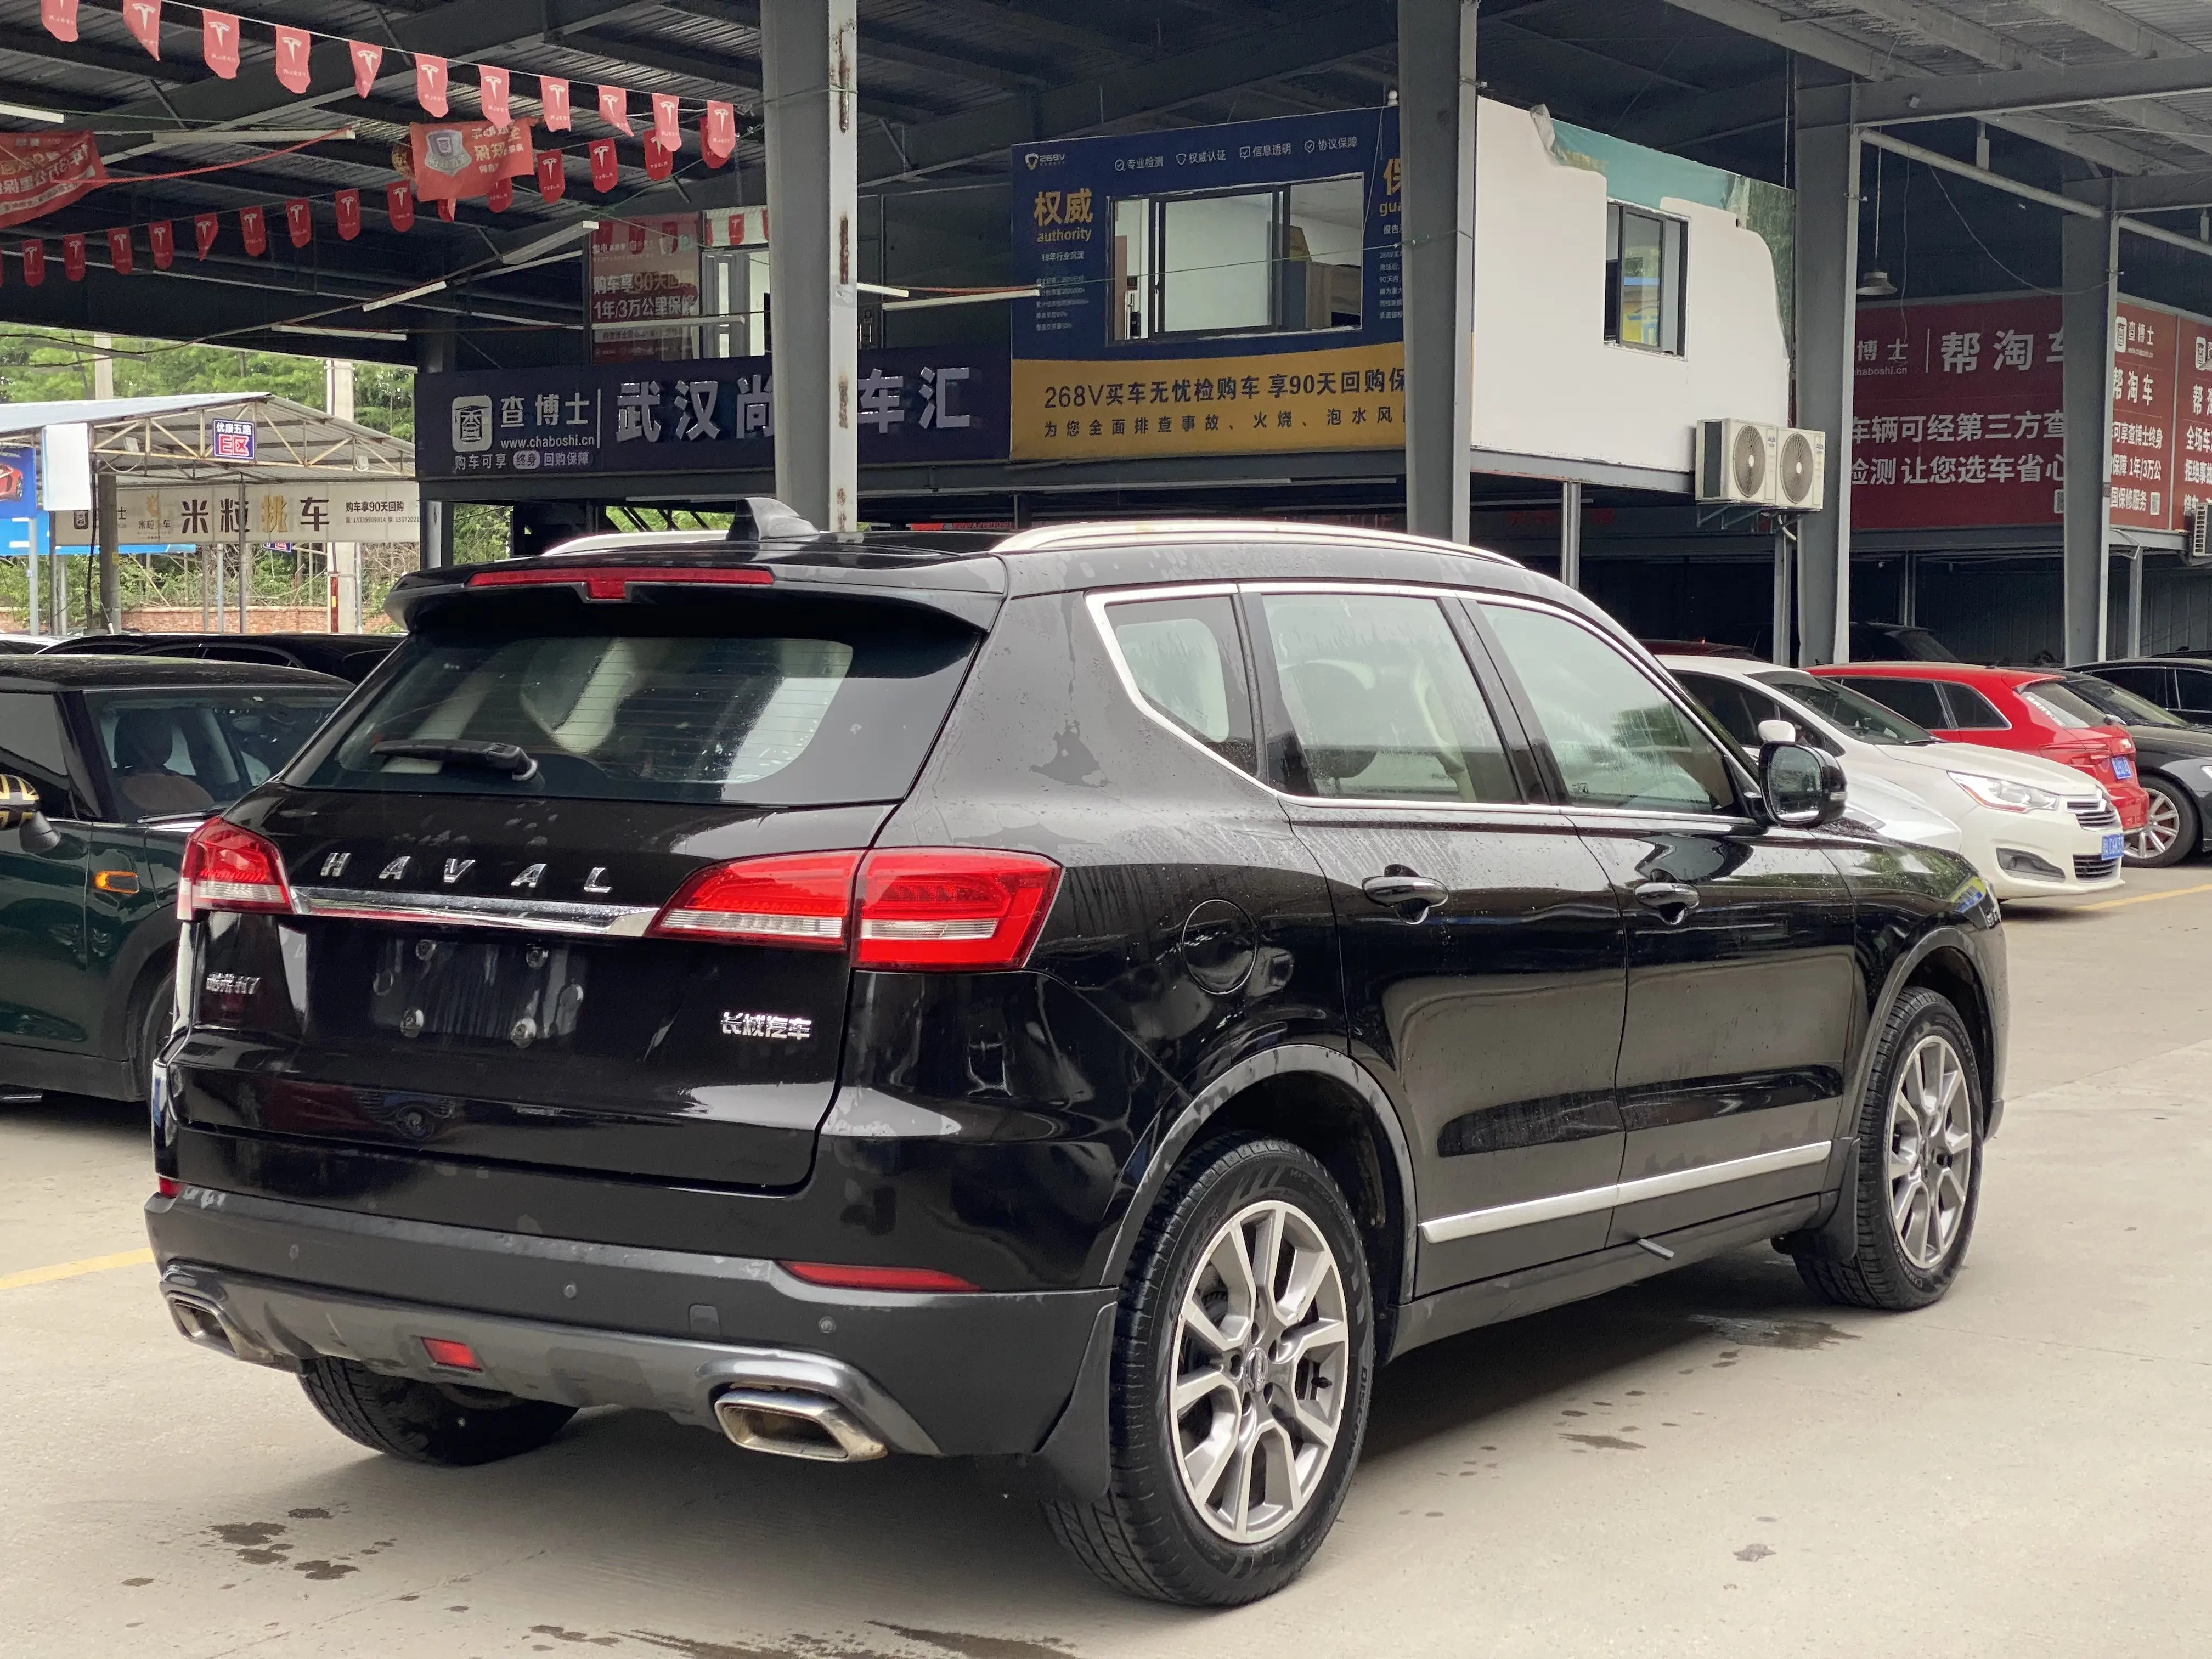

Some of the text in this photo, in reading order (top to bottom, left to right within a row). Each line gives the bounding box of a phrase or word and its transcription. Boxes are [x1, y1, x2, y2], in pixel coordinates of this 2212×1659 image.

[1127, 136, 1357, 170] 专业检测 权威认证 信息透明 协议保障
[1034, 188, 1093, 226] 权威
[1037, 227, 1092, 242] authority
[1857, 338, 1908, 362] 博士
[1854, 365, 1907, 376] haboshi.cn
[1044, 368, 1405, 408] 268V买车无忧检购车 享90天回购保
[501, 392, 590, 428] 查博士
[1044, 406, 1406, 438] 为您全面排查事故、火烧、泡水风
[219, 434, 250, 456] E区
[501, 435, 595, 449] www.chaboshi.cn
[2112, 421, 2163, 449] 可享查博士终身
[2186, 425, 2212, 453] 全场车
[455, 453, 507, 471] 购车可享
[544, 452, 589, 467] 回购保障
[1901, 454, 2064, 484] 让您选车省心
[2112, 453, 2127, 476] 保障
[346, 501, 404, 512] 购车享90天回购
[320, 852, 613, 893] HAVAL
[720, 1012, 812, 1040] 长城汽车
